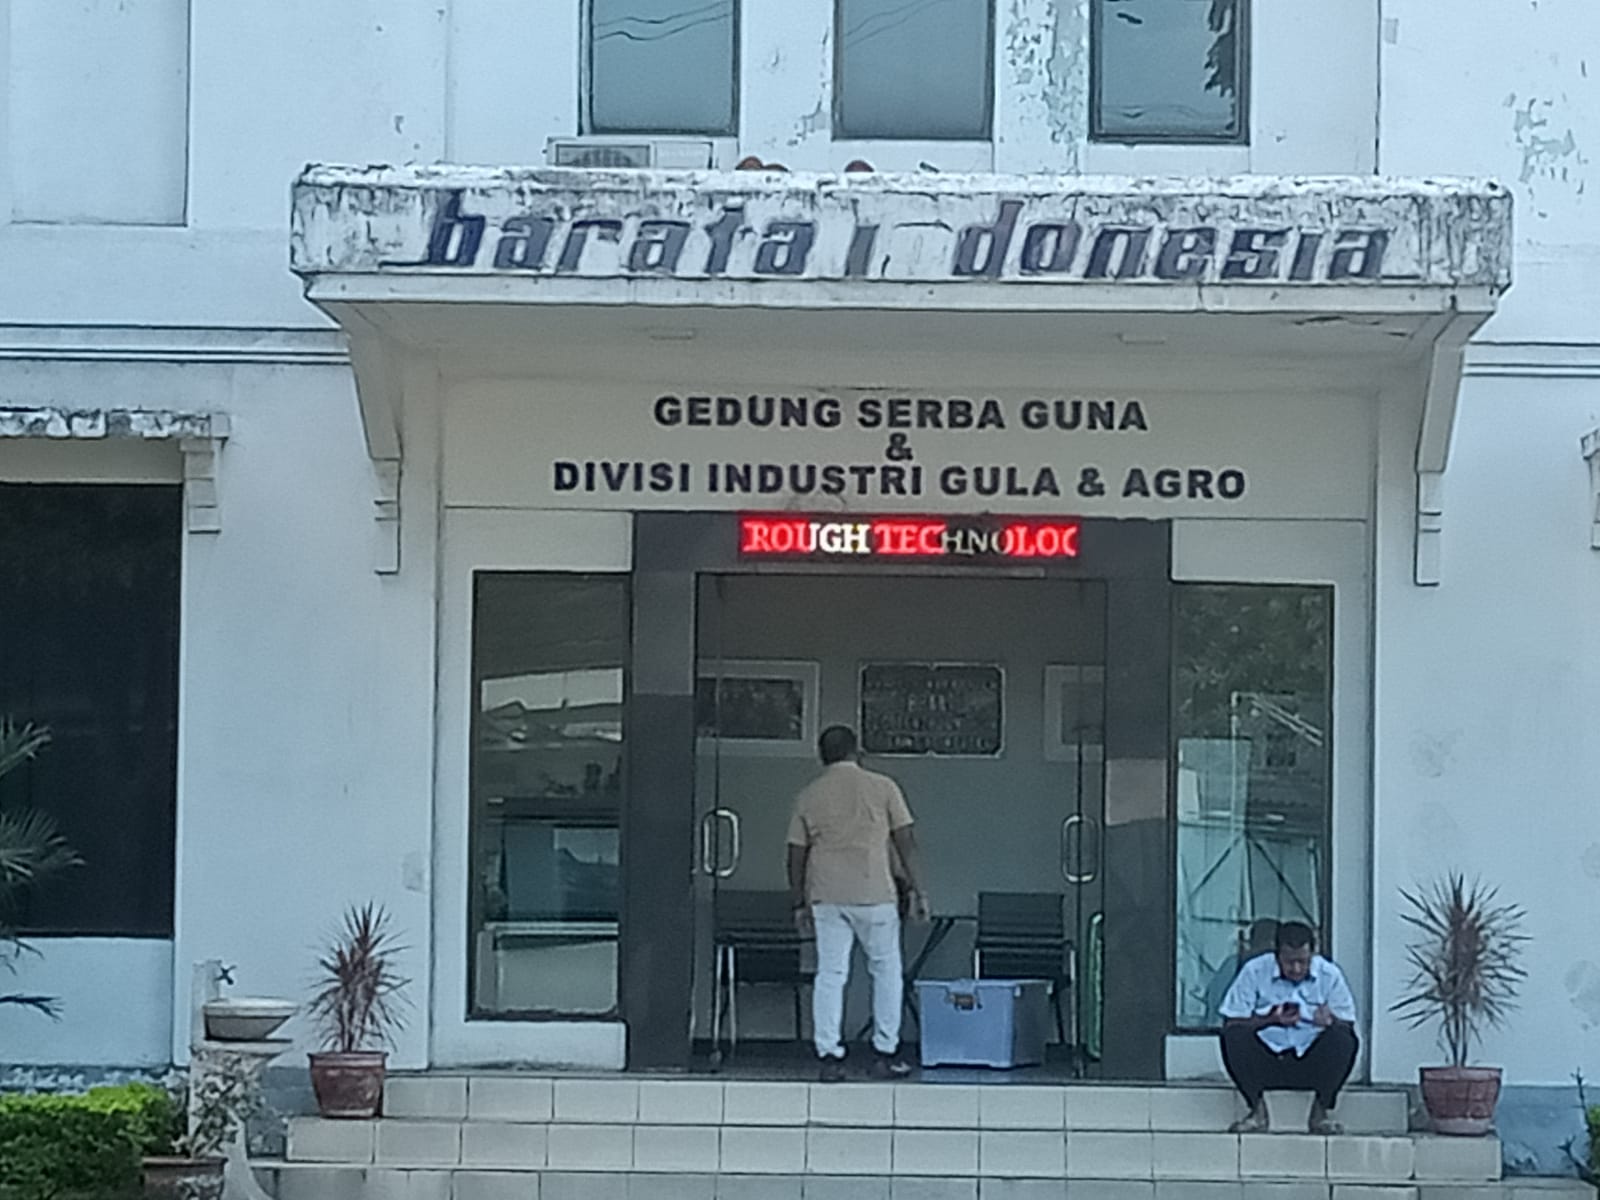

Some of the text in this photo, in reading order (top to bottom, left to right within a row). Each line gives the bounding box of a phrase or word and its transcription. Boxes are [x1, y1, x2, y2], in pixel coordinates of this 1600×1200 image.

[845, 198, 1390, 281] idonesia
[653, 396, 1148, 431] GEDUNG SERBA GUNA
[885, 432, 913, 462] &
[554, 461, 1246, 499] DIVISI INDUSTRI GULA & AGRO
[742, 522, 871, 553] ROUGH
